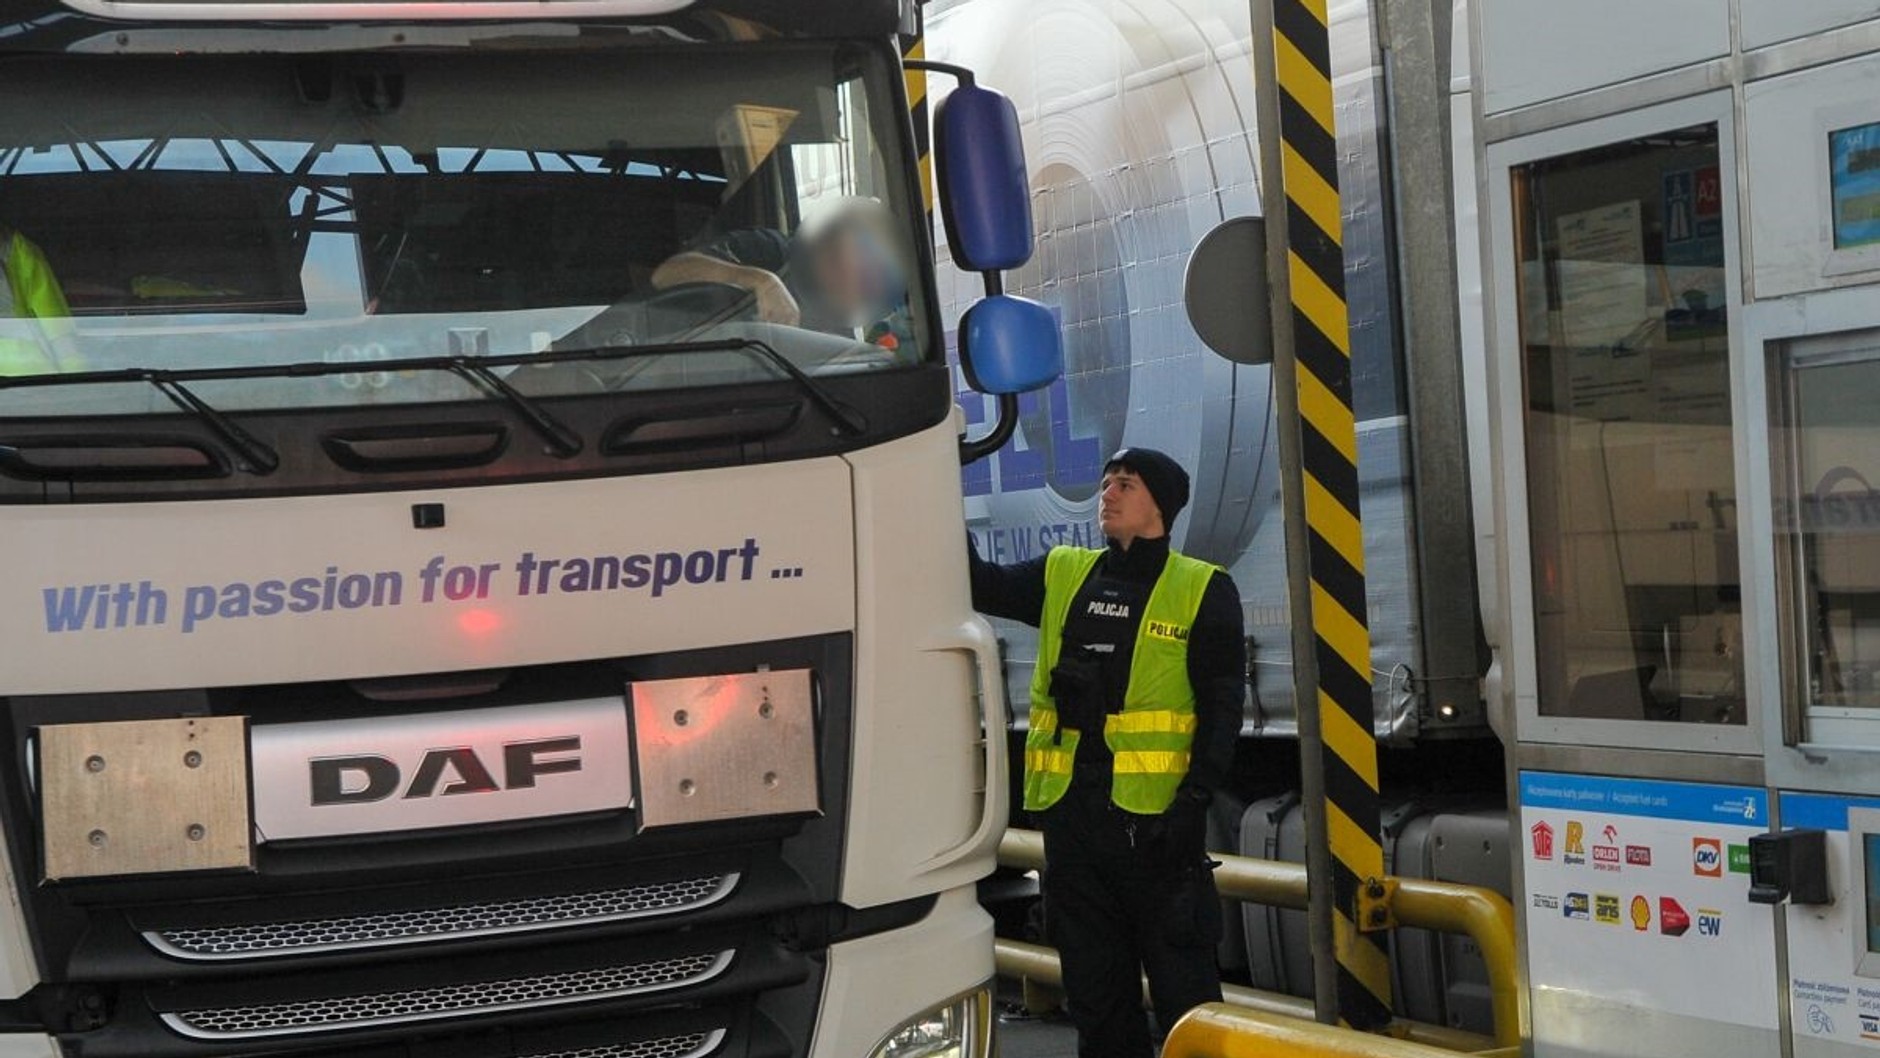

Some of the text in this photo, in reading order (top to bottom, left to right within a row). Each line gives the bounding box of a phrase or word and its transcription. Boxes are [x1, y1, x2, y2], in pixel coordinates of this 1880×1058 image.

[42, 581, 168, 633] With
[181, 566, 403, 633] passion
[419, 555, 500, 603] for
[515, 538, 760, 598] transport
[1087, 601, 1130, 618] POLICJA
[308, 735, 582, 807] DAF
[1594, 847, 1619, 861] ORLEN
[1696, 850, 1719, 864] DKV
